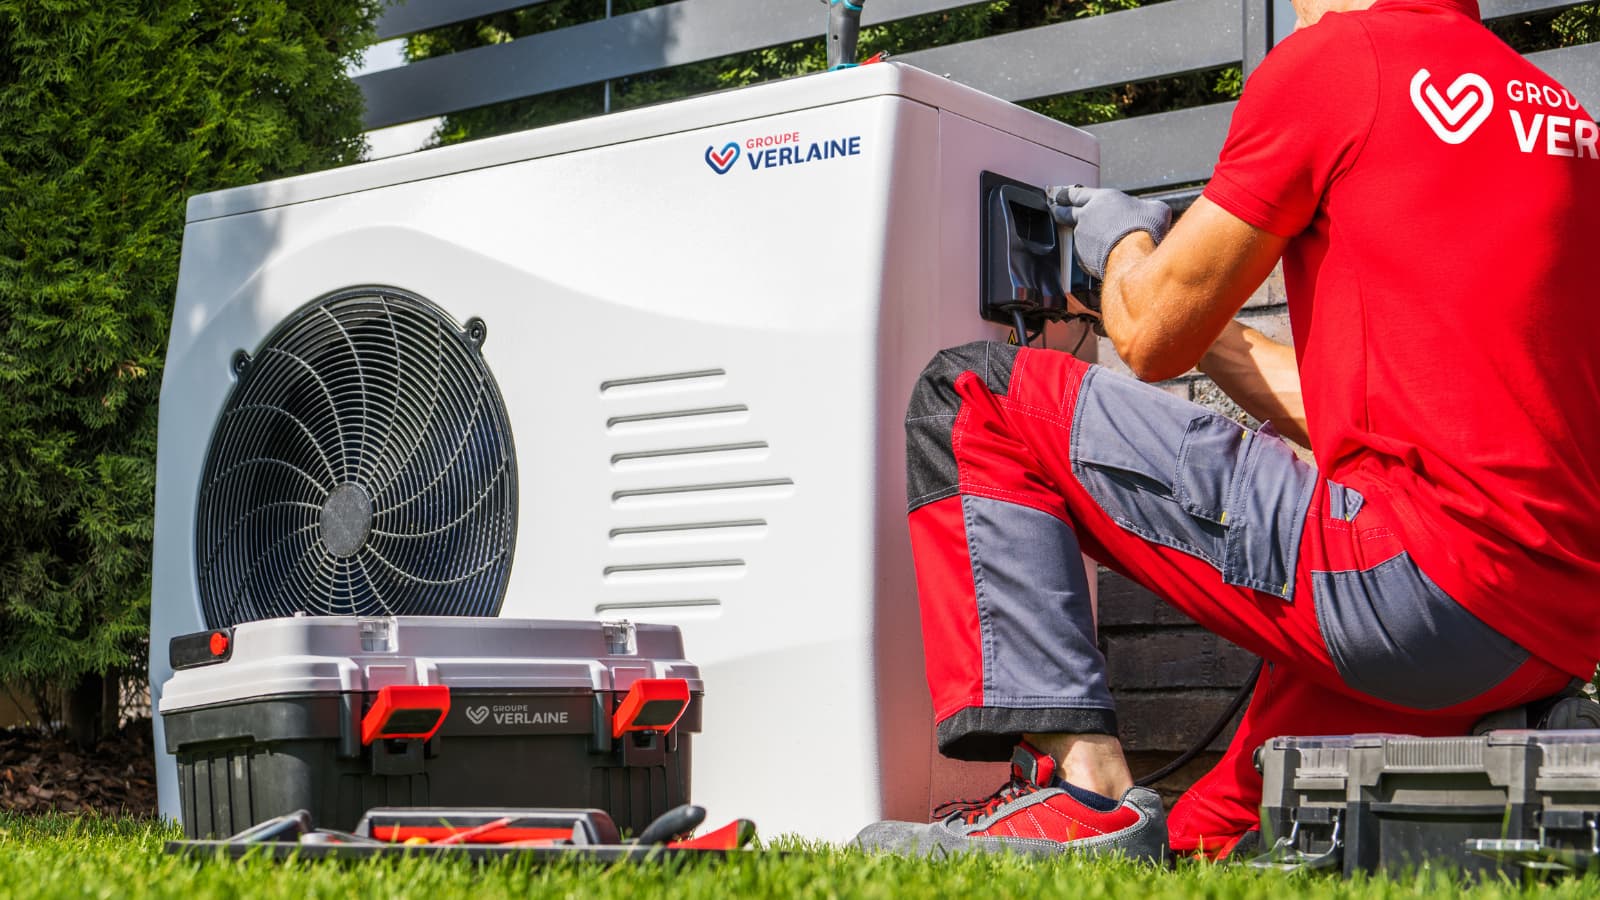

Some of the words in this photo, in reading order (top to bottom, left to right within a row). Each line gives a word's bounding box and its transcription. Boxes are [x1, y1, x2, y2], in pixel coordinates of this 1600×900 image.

[746, 132, 800, 149] GROUPE
[1508, 109, 1600, 160] VER
[747, 136, 861, 170] VERLAINE
[492, 704, 528, 712] GROUPE
[493, 712, 569, 725] VERLAINE
